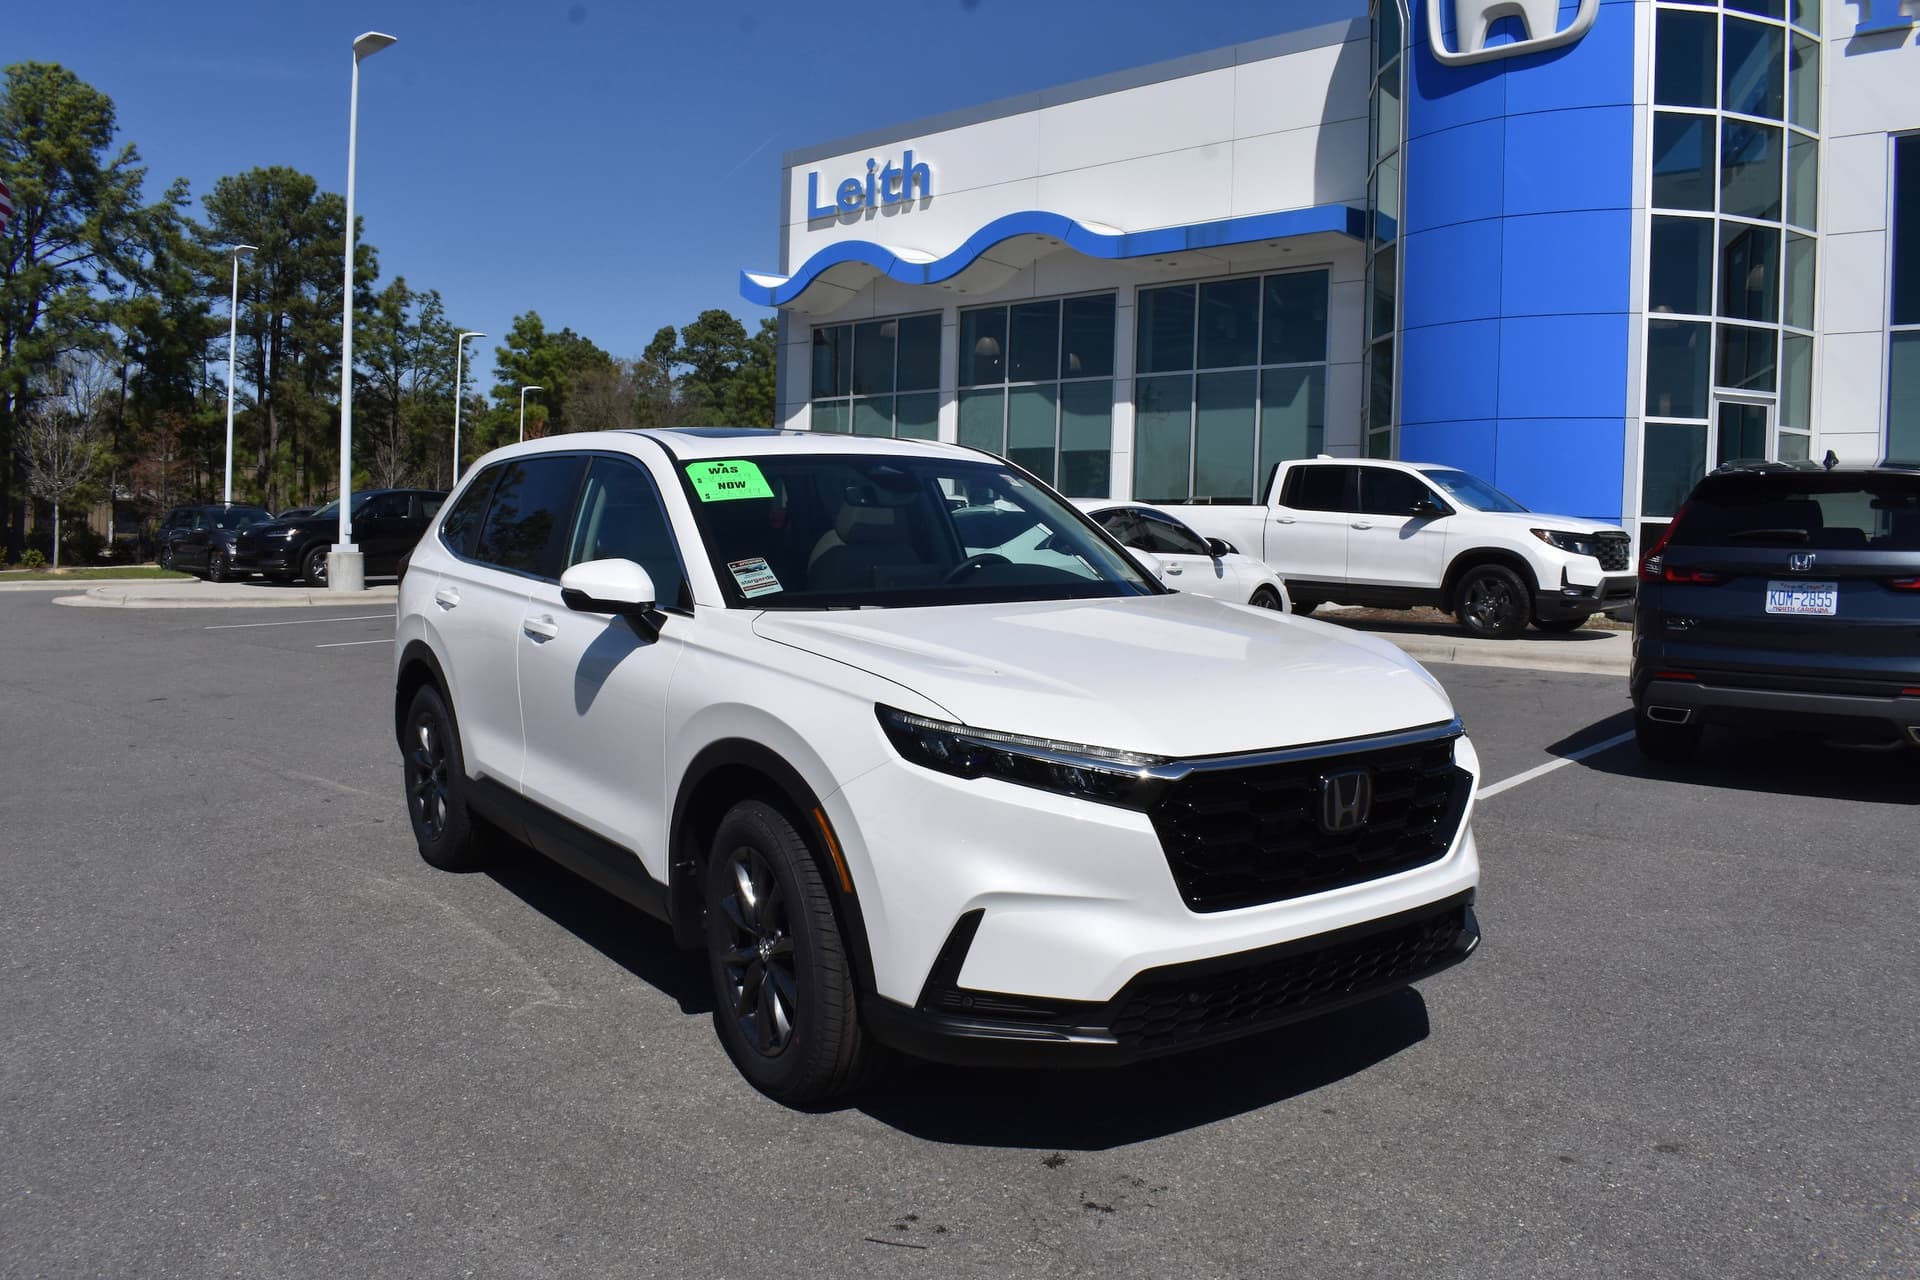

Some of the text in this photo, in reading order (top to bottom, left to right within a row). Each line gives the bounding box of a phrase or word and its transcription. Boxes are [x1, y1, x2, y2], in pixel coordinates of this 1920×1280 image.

[808, 150, 931, 220] Leith
[708, 466, 739, 475] WAS
[718, 481, 746, 490] NOW
